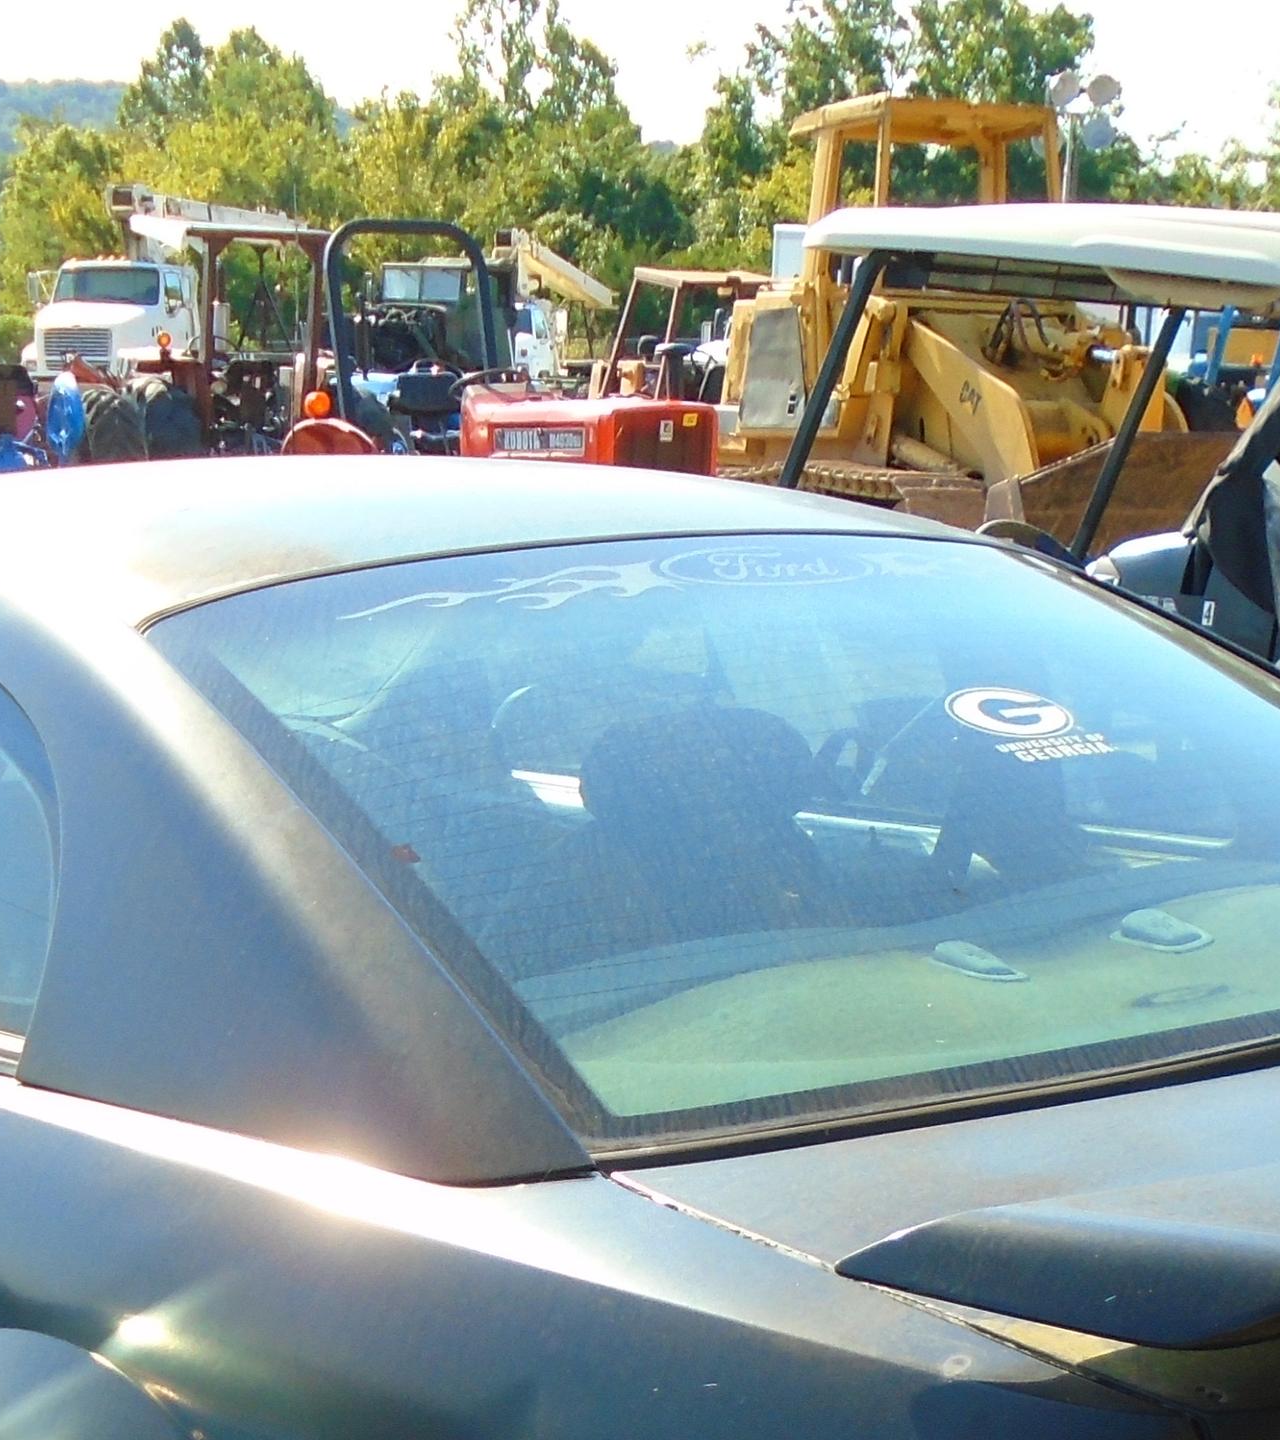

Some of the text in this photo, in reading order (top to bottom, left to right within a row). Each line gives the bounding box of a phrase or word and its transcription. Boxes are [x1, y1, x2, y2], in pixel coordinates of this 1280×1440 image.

[959, 379, 982, 416] CAT
[504, 430, 540, 450] KUBOTA
[706, 551, 839, 581] Ford
[950, 688, 1069, 736] G
[995, 732, 1105, 753] UNIVERSITY OF
[1014, 741, 1115, 763] GEORGIA
